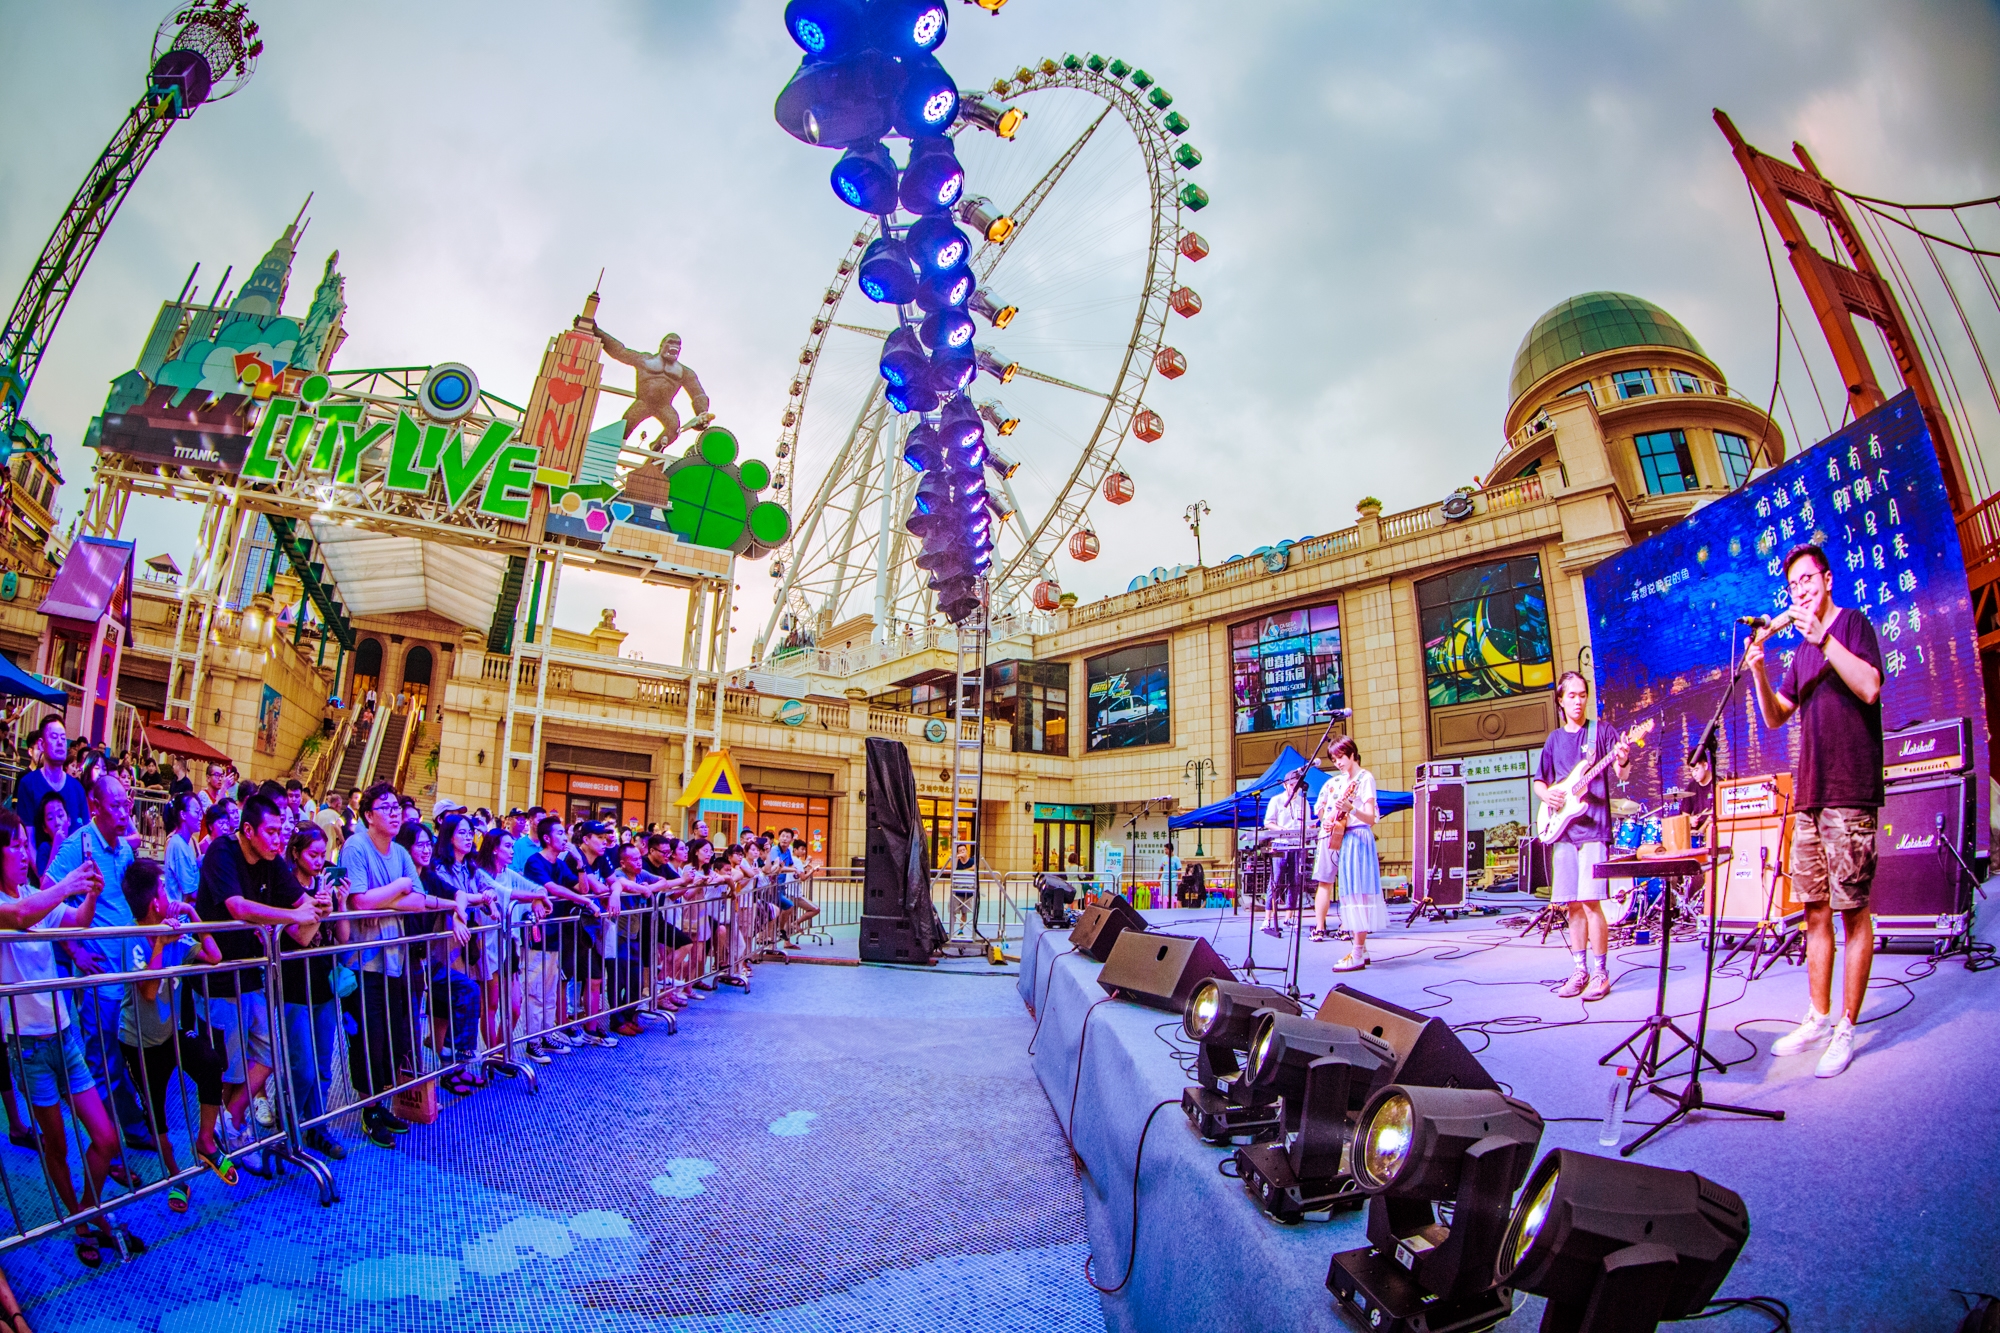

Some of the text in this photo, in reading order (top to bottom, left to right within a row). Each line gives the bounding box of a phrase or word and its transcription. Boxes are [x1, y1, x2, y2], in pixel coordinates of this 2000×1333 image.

[240, 362, 542, 524] CITY LIVE
[174, 446, 220, 462] TITANIC
[1793, 477, 1816, 544] 我想
[1868, 433, 1925, 664] 有个月亮睡着了
[1847, 446, 1906, 678] 有颗星星在唱歌
[1264, 652, 1305, 670] 世嘉都市
[1264, 667, 1306, 685] 体育乐园
[1290, 683, 1306, 691] SOON
[1898, 738, 1936, 757] Marshall
[1467, 762, 1526, 776] 查果拉 牦牛料理
[1895, 833, 1935, 850] Marshall
